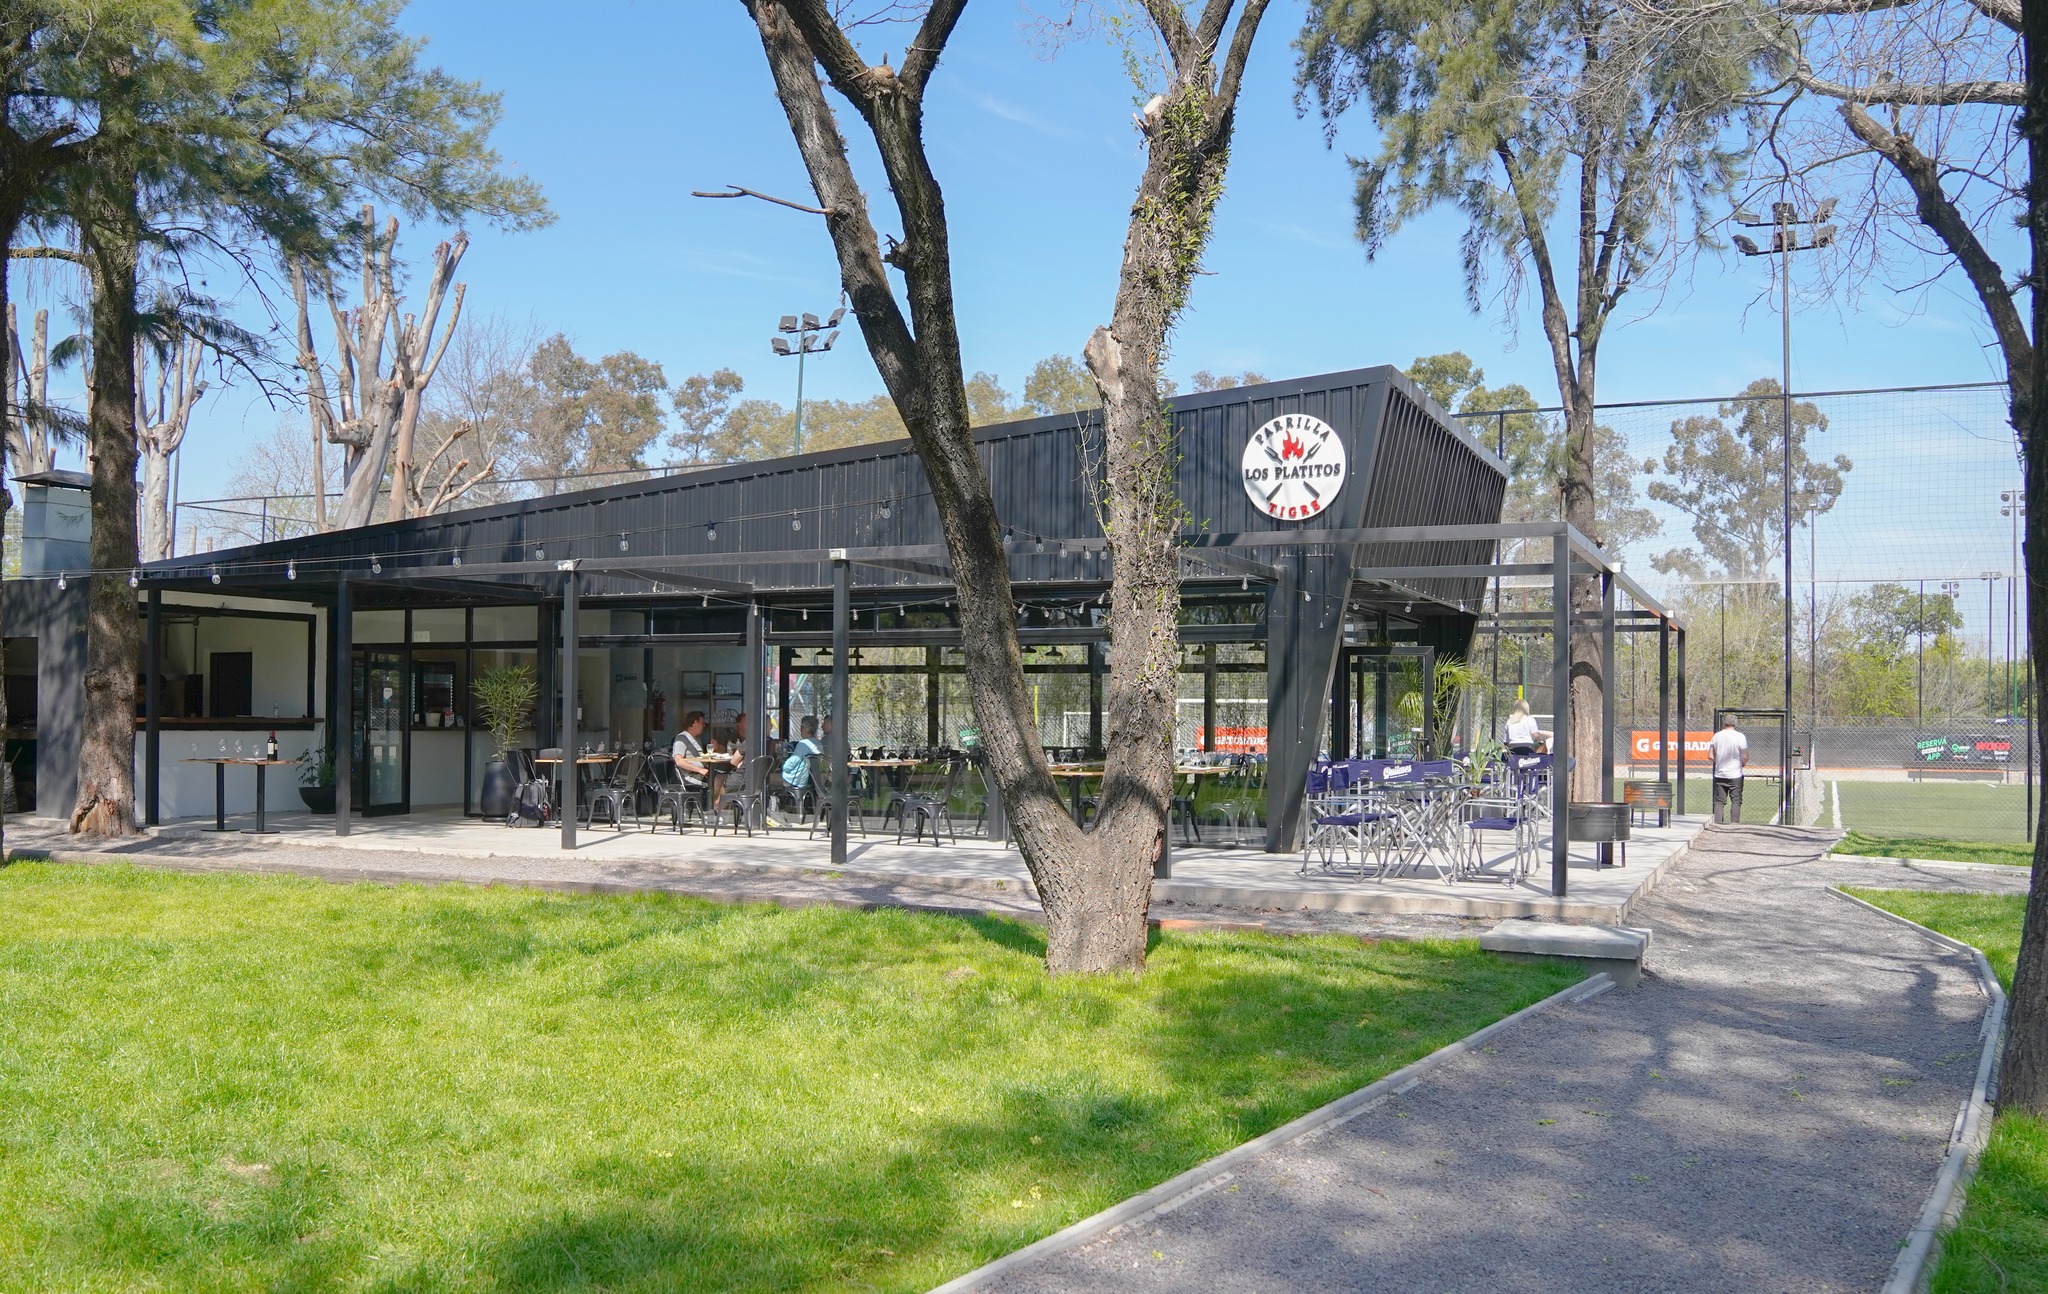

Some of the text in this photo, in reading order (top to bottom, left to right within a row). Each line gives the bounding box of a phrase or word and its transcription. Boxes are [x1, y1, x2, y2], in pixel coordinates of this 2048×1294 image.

[1254, 416, 1331, 446] PARRILLA
[1245, 462, 1341, 481] LOS PLATITOS
[1268, 499, 1321, 519] TIGRE
[1636, 738, 1650, 753] G
[1383, 764, 1412, 780] Quilmes
